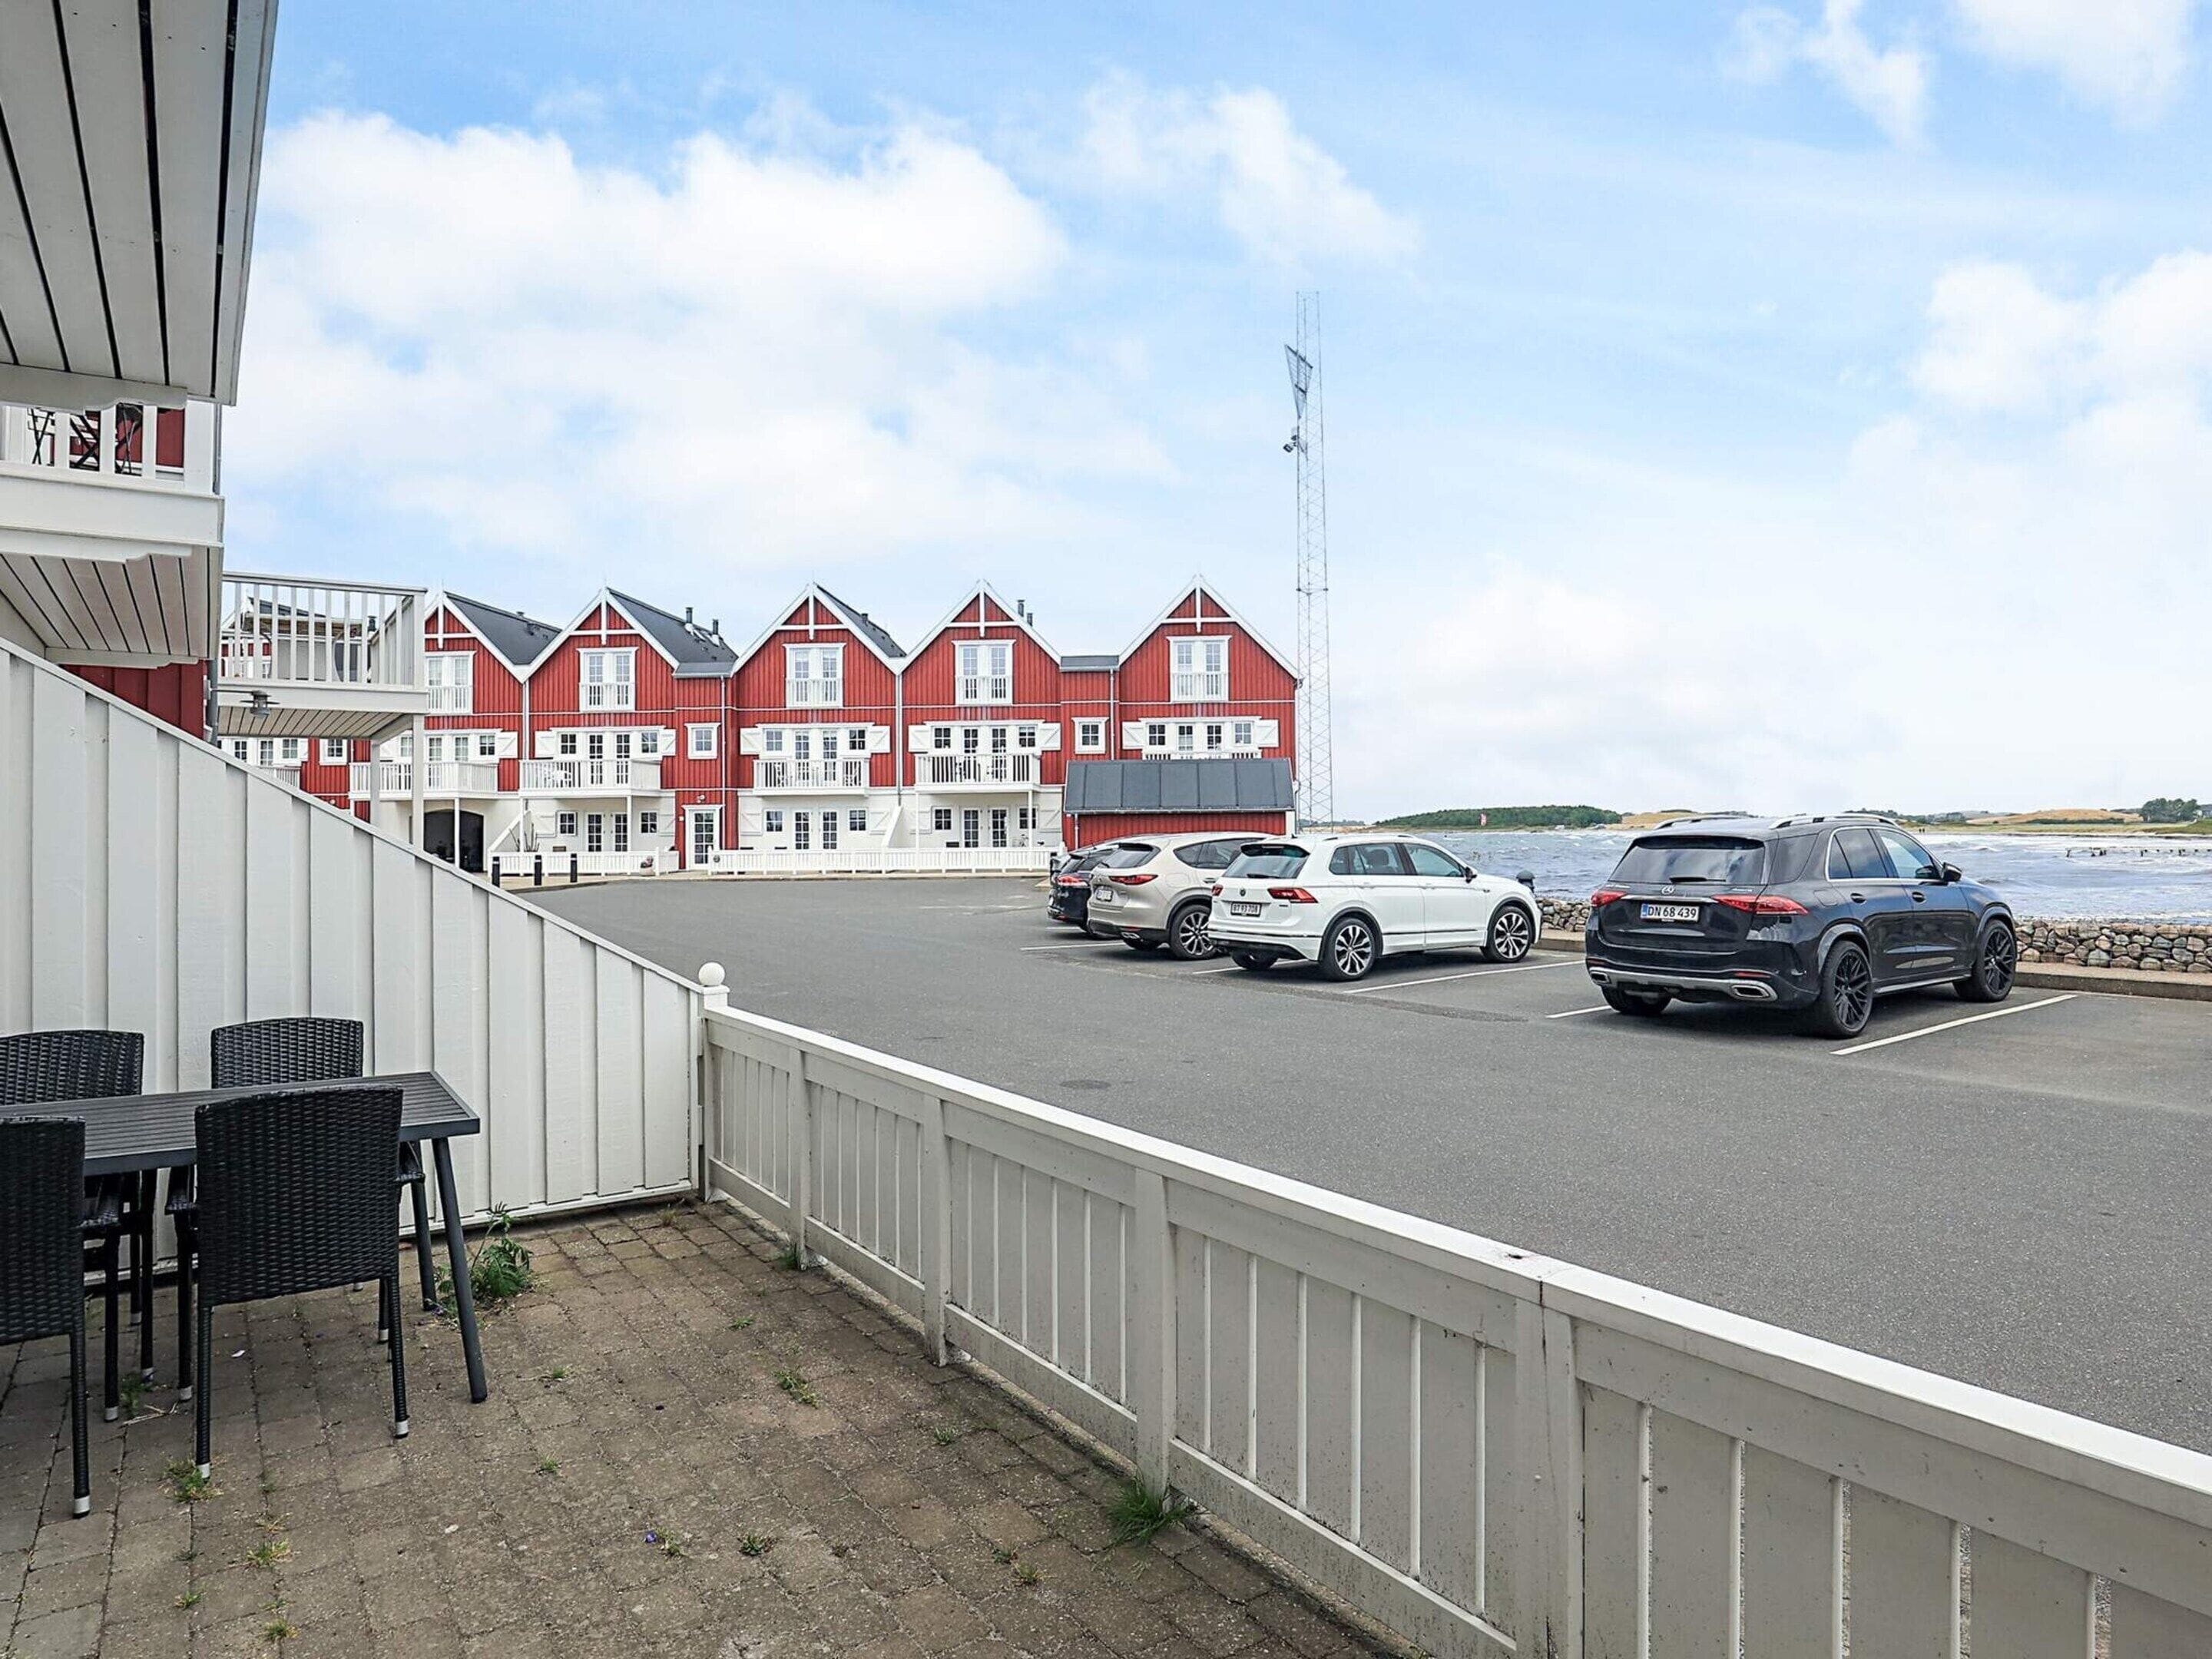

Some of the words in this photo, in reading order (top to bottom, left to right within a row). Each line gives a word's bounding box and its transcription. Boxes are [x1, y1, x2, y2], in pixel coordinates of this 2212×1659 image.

[1648, 906, 1661, 916] DN
[1663, 907, 1676, 917] 68
[1677, 908, 1697, 919] 439
